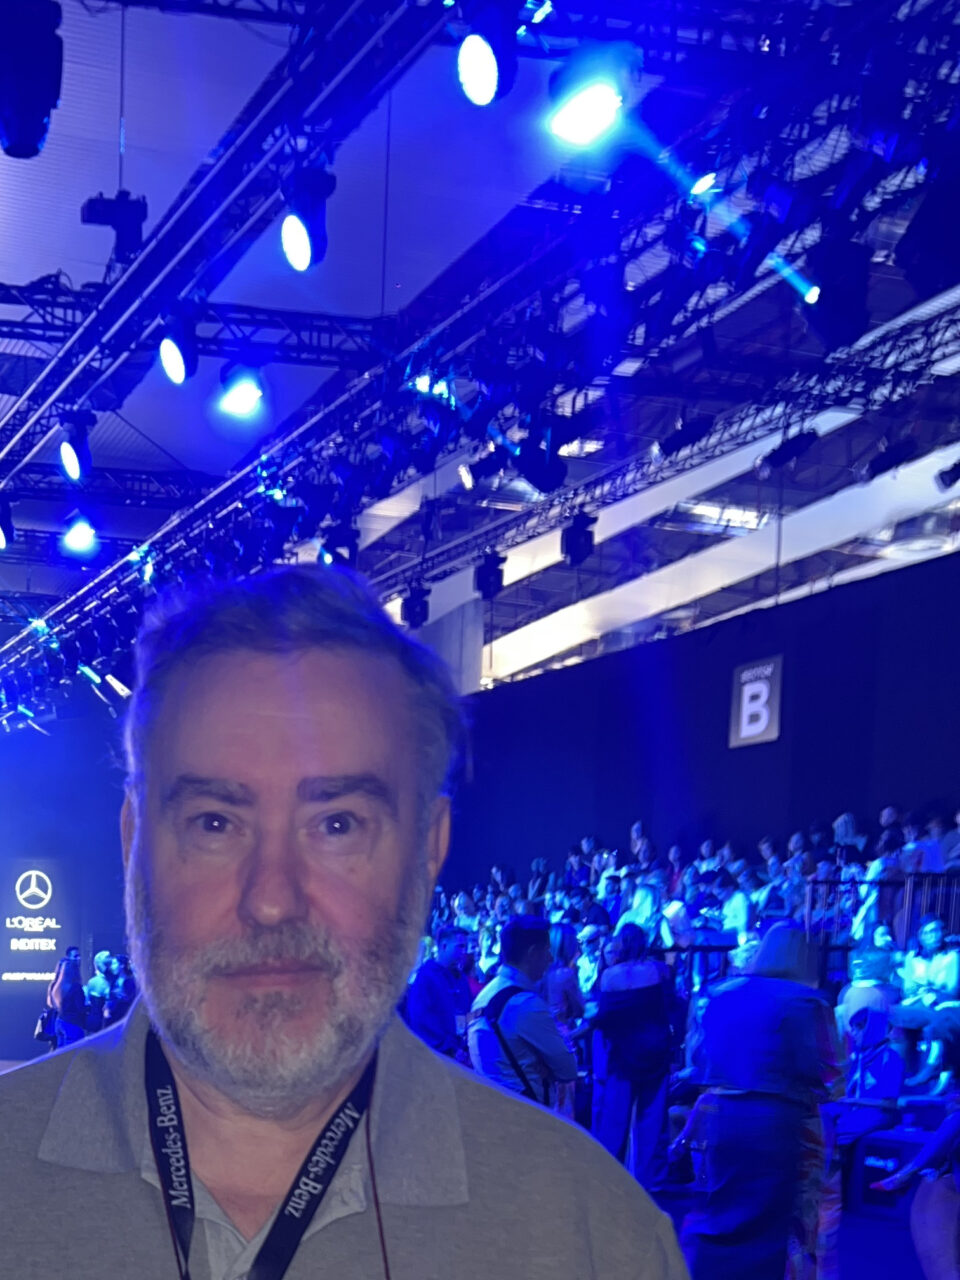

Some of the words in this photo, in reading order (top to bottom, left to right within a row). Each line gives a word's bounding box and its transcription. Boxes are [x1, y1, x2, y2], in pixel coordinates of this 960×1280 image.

[740, 680, 770, 739] B
[10, 938, 56, 951] INDITEX
[156, 1085, 191, 1209] Mercedes-Benz
[284, 1102, 360, 1219] Mercedes-Benz
